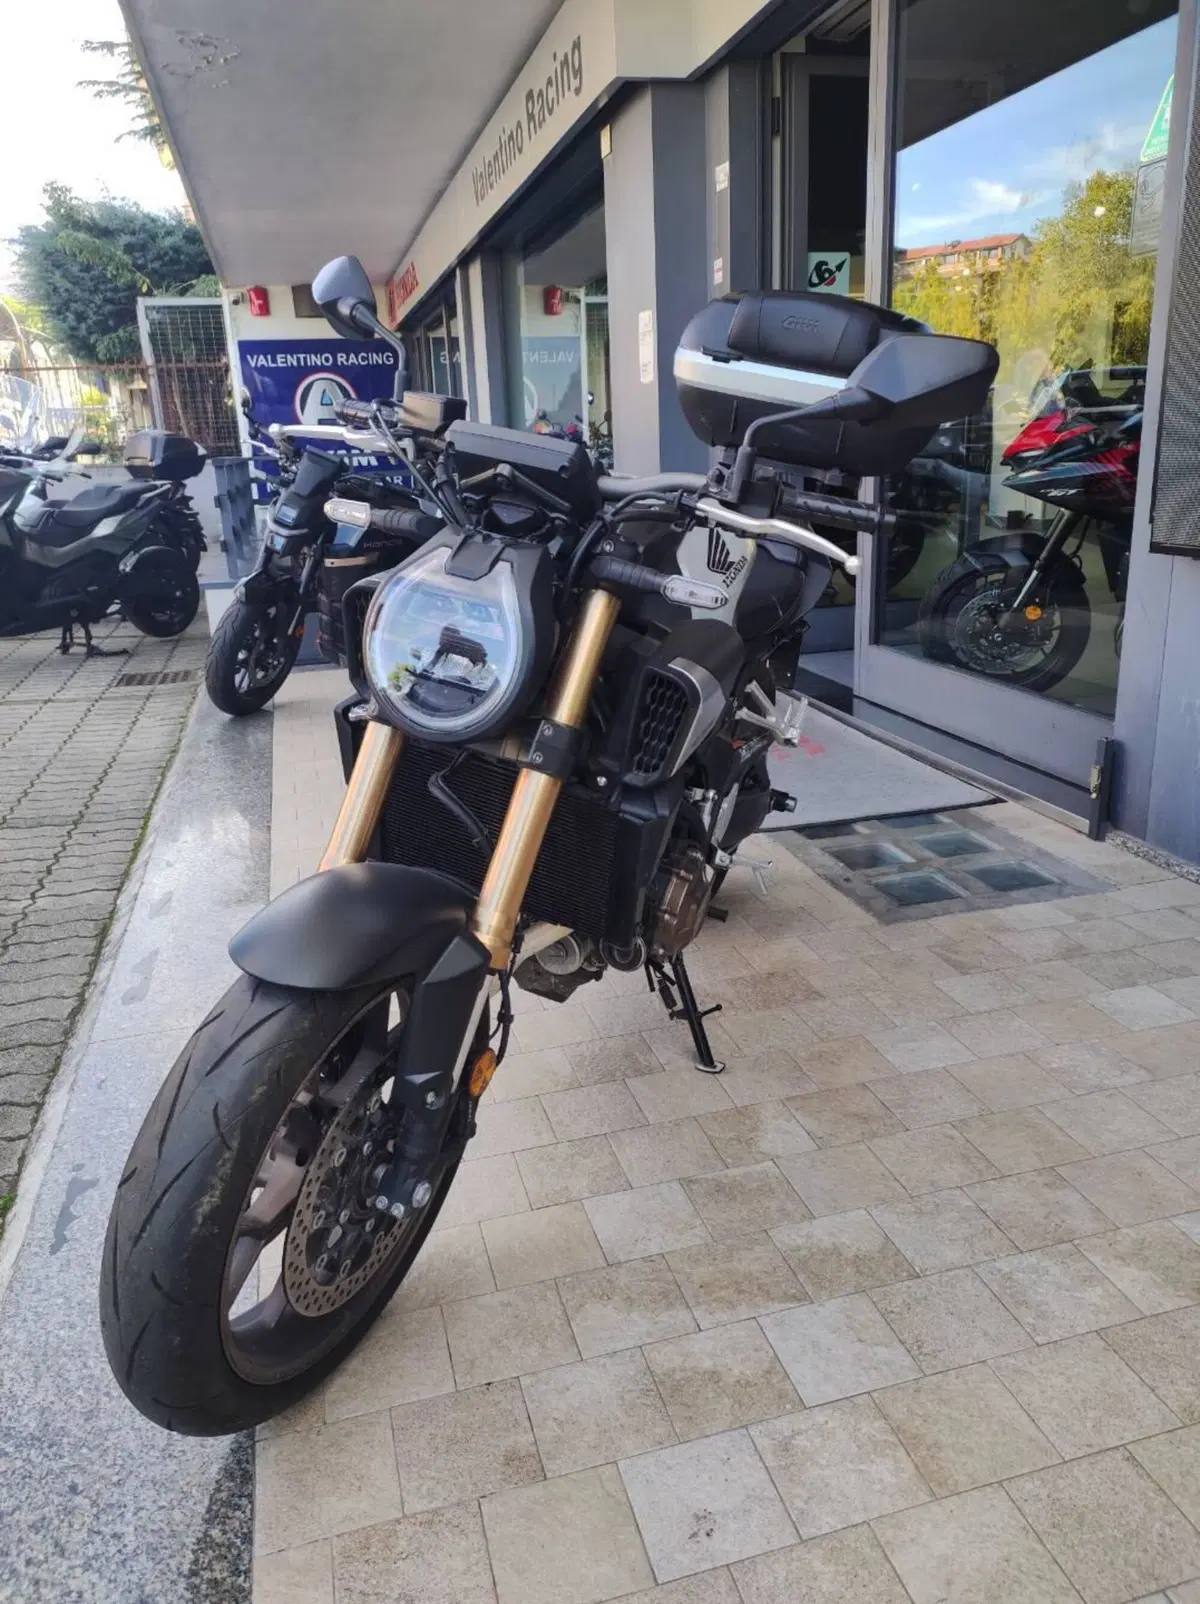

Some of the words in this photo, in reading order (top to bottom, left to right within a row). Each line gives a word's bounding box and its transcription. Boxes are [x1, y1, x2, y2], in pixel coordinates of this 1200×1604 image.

[471, 119, 524, 207] Valentino
[525, 35, 584, 142] Racing
[246, 352, 333, 368] VALENTINO
[337, 352, 394, 366] RACING
[722, 555, 749, 589] HONDA
